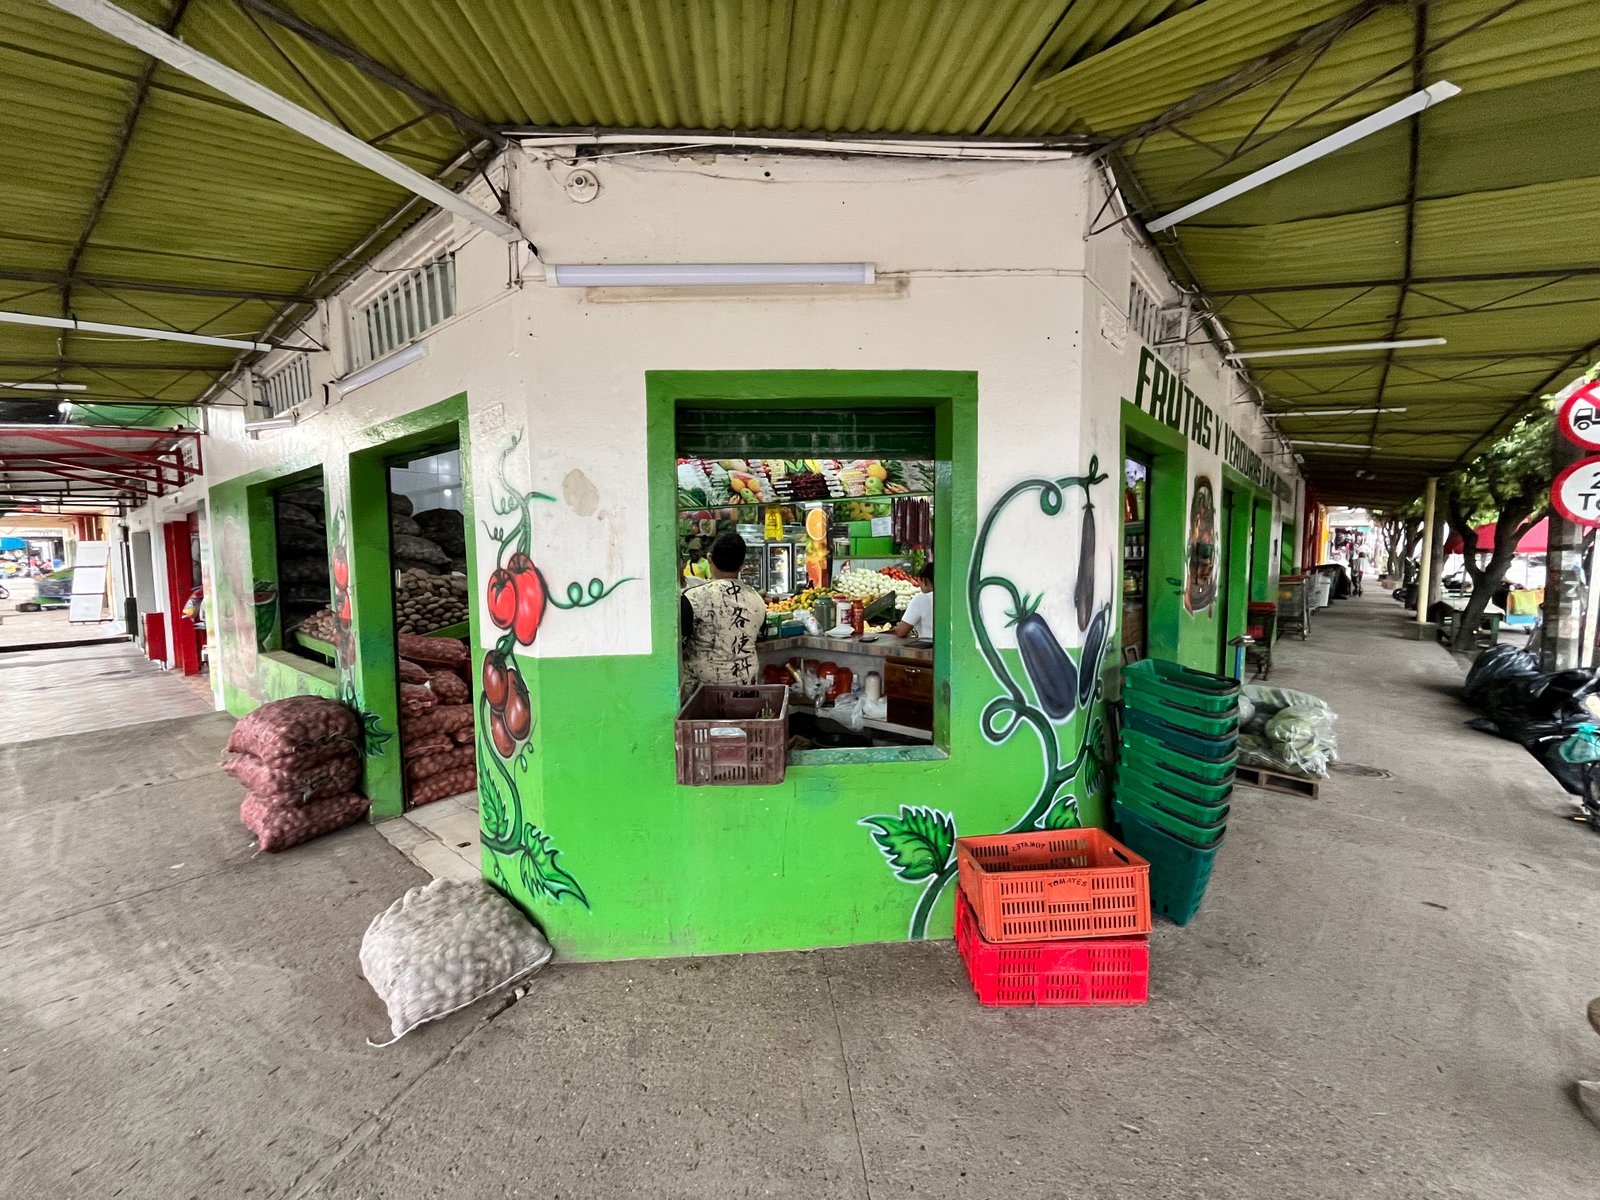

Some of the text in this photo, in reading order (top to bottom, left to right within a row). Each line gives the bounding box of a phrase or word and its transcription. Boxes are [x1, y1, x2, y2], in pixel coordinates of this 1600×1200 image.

[1135, 346, 1213, 450] FRUTAS
[1215, 414, 1223, 455] Y
[1225, 422, 1262, 485] VERDURAS
